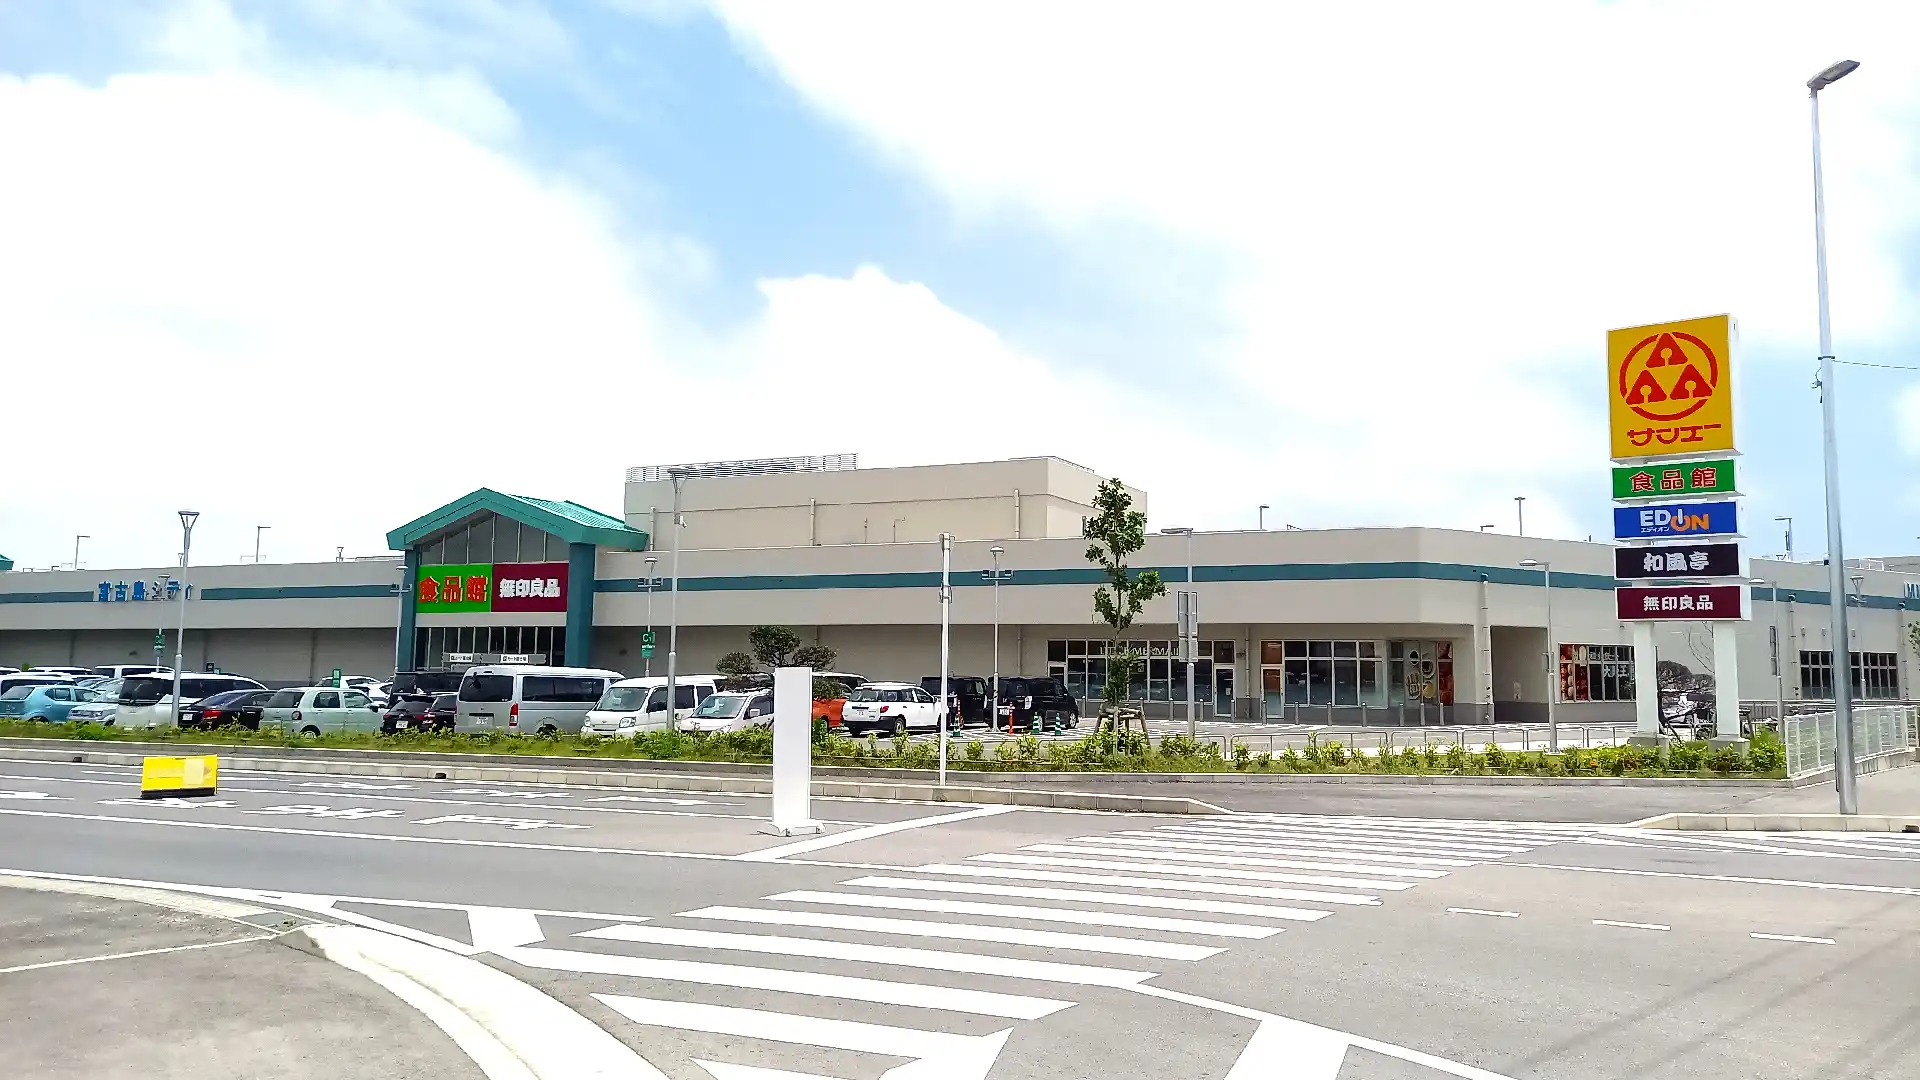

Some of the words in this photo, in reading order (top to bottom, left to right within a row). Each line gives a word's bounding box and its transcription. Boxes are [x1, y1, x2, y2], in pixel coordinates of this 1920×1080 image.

[1627, 423, 1721, 447] サンエー
[1630, 467, 1717, 492] 食品館
[1640, 509, 1709, 532] EDION
[1643, 551, 1709, 571] 和風亭
[419, 575, 489, 603] 食品館
[499, 578, 561, 598] 無印良品
[1643, 595, 1714, 611] 無印良品
